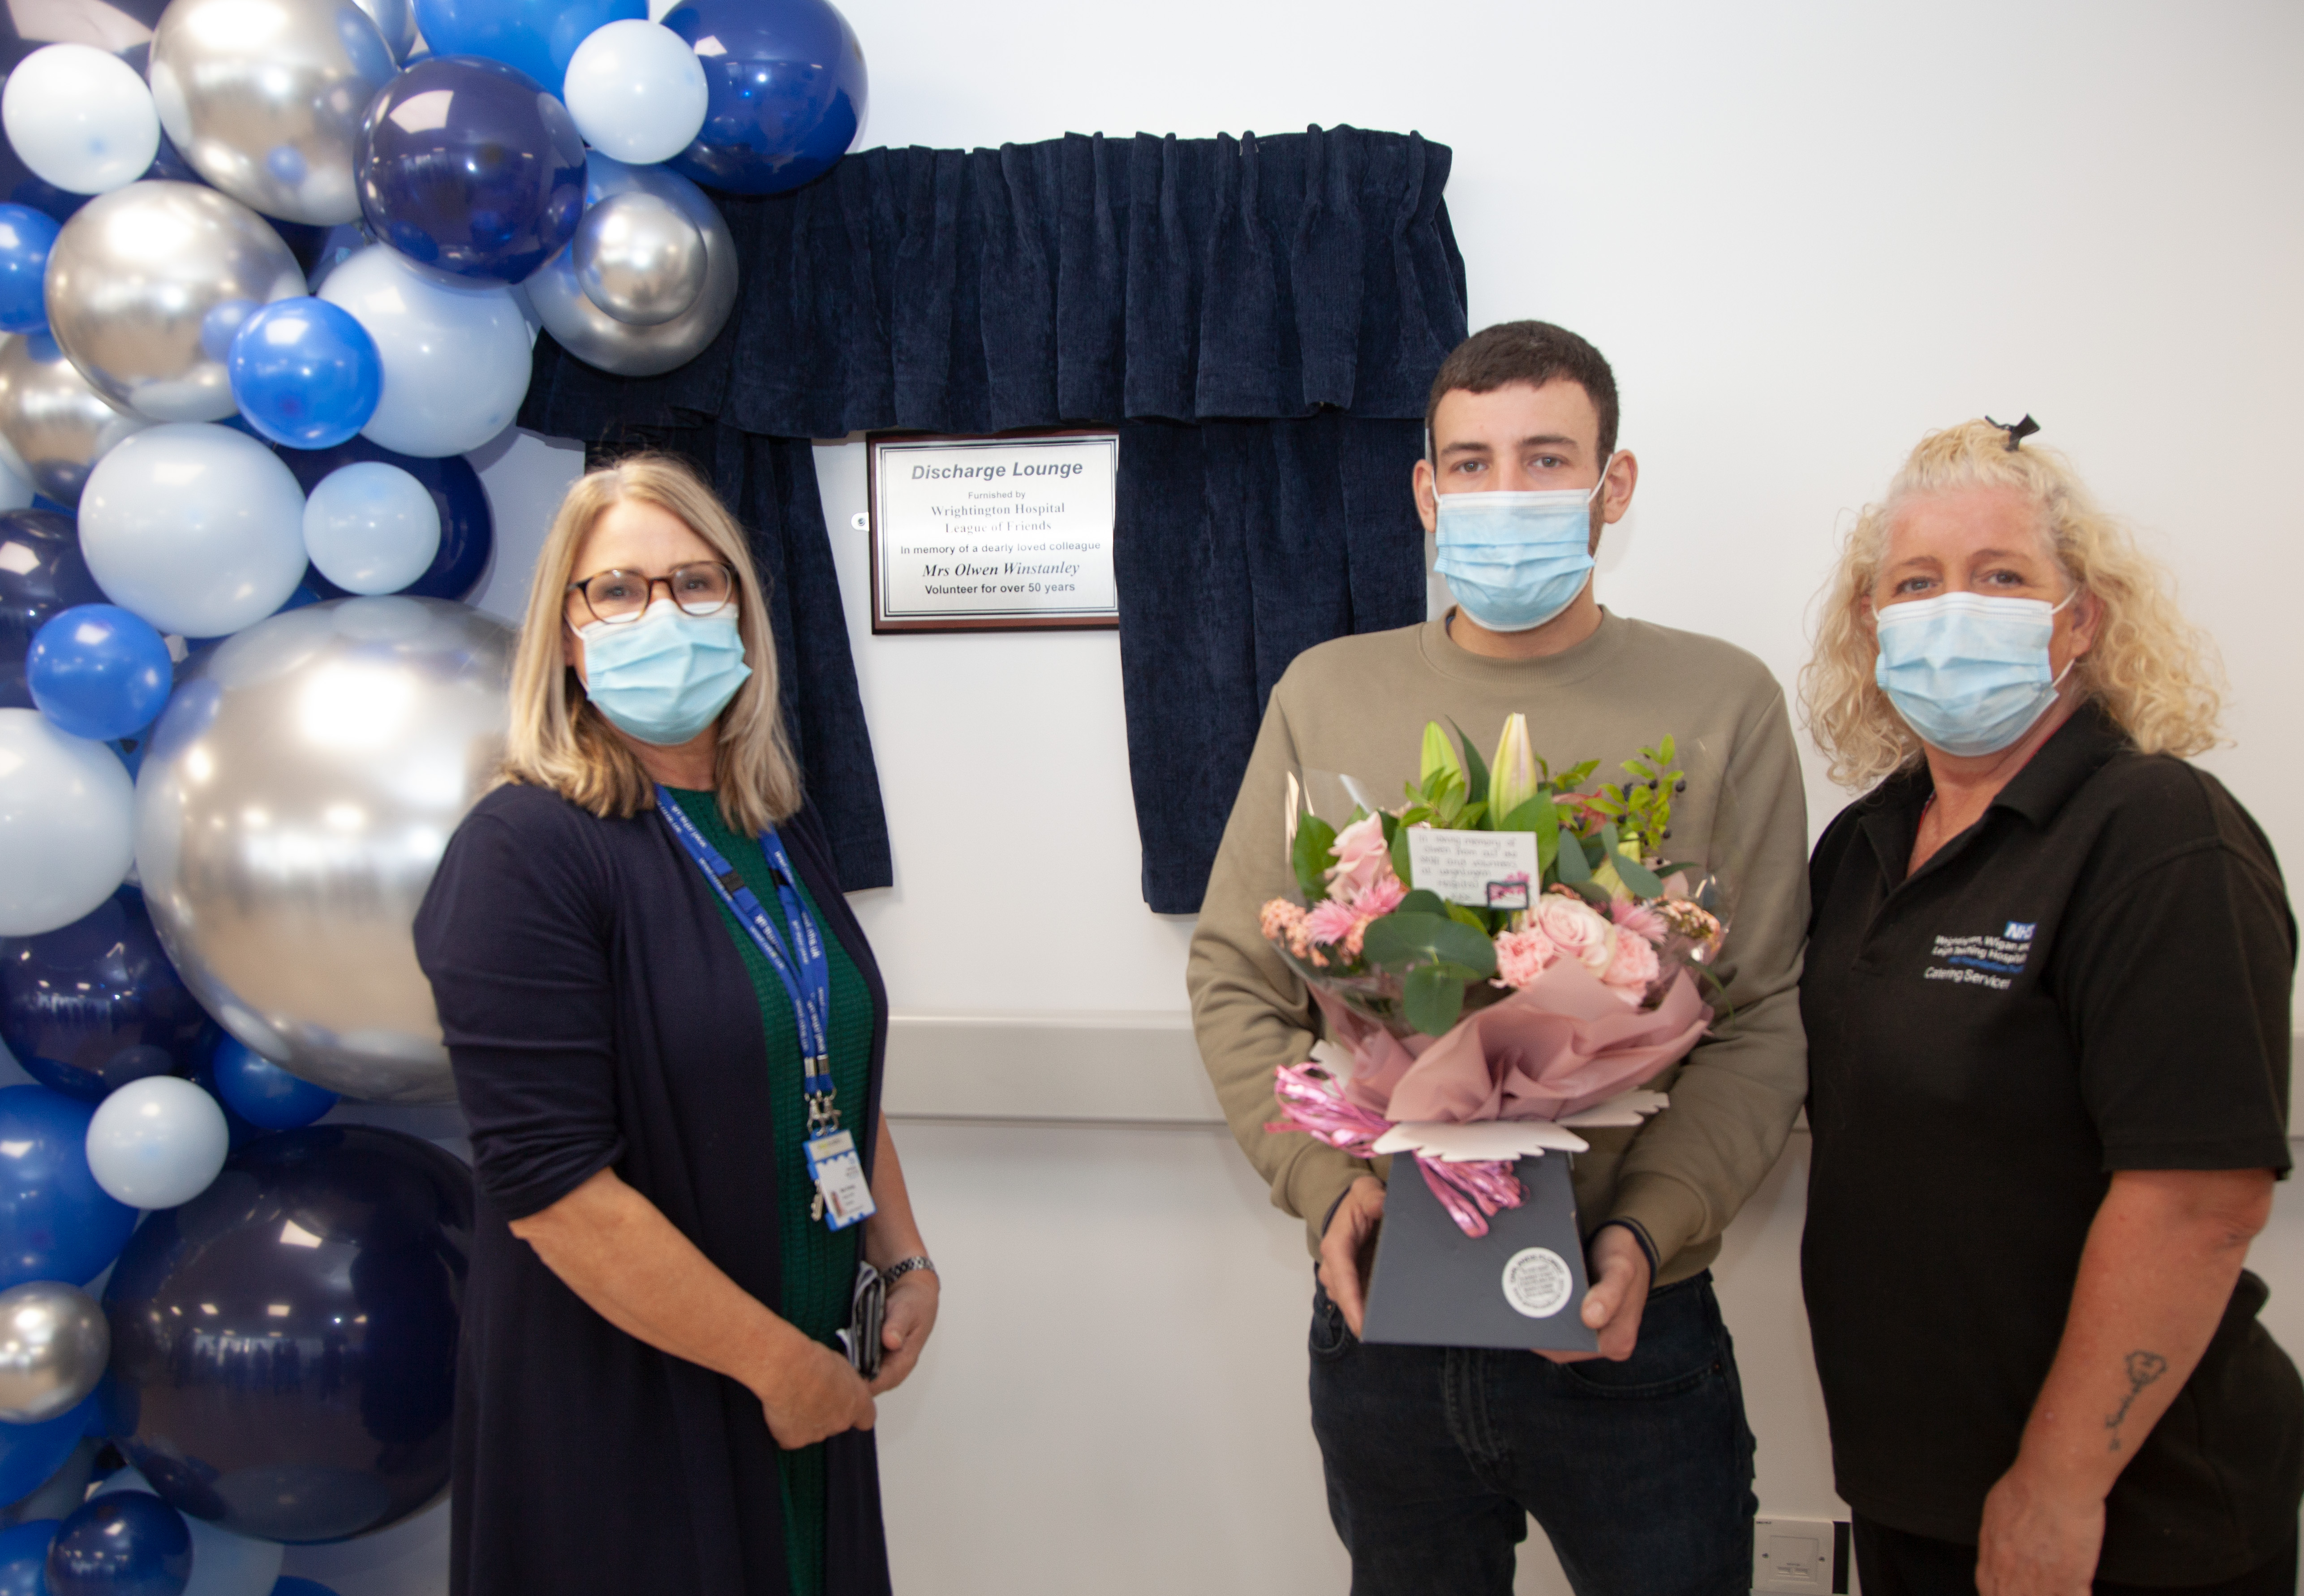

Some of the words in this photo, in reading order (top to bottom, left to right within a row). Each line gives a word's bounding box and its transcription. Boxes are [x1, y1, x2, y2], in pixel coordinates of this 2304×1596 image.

[911, 463, 1006, 481] Discharge
[1012, 461, 1083, 478] Lounge
[968, 491, 1013, 499] Furnished
[1015, 491, 1026, 499] by
[931, 505, 1011, 518] Wrightington
[1015, 503, 1065, 516] Hospital
[946, 523, 987, 535] League
[991, 522, 1004, 532] of
[1007, 521, 1052, 532] Friends
[901, 546, 910, 554] In
[913, 546, 955, 555] memory
[959, 544, 969, 553] of
[982, 543, 1013, 554] dearly
[1017, 542, 1046, 551] loved
[1049, 541, 1101, 552] colleague
[922, 564, 950, 577] Mrs
[955, 563, 999, 576] Olwen
[1003, 561, 1080, 576] Winstanley
[925, 584, 978, 594] Volunteer
[981, 583, 997, 594] for
[1000, 585, 1025, 593] over
[1028, 583, 1041, 593] 50
[1045, 583, 1075, 594] years
[1983, 935, 2018, 950] Wigan
[1924, 966, 1964, 983] Catering
